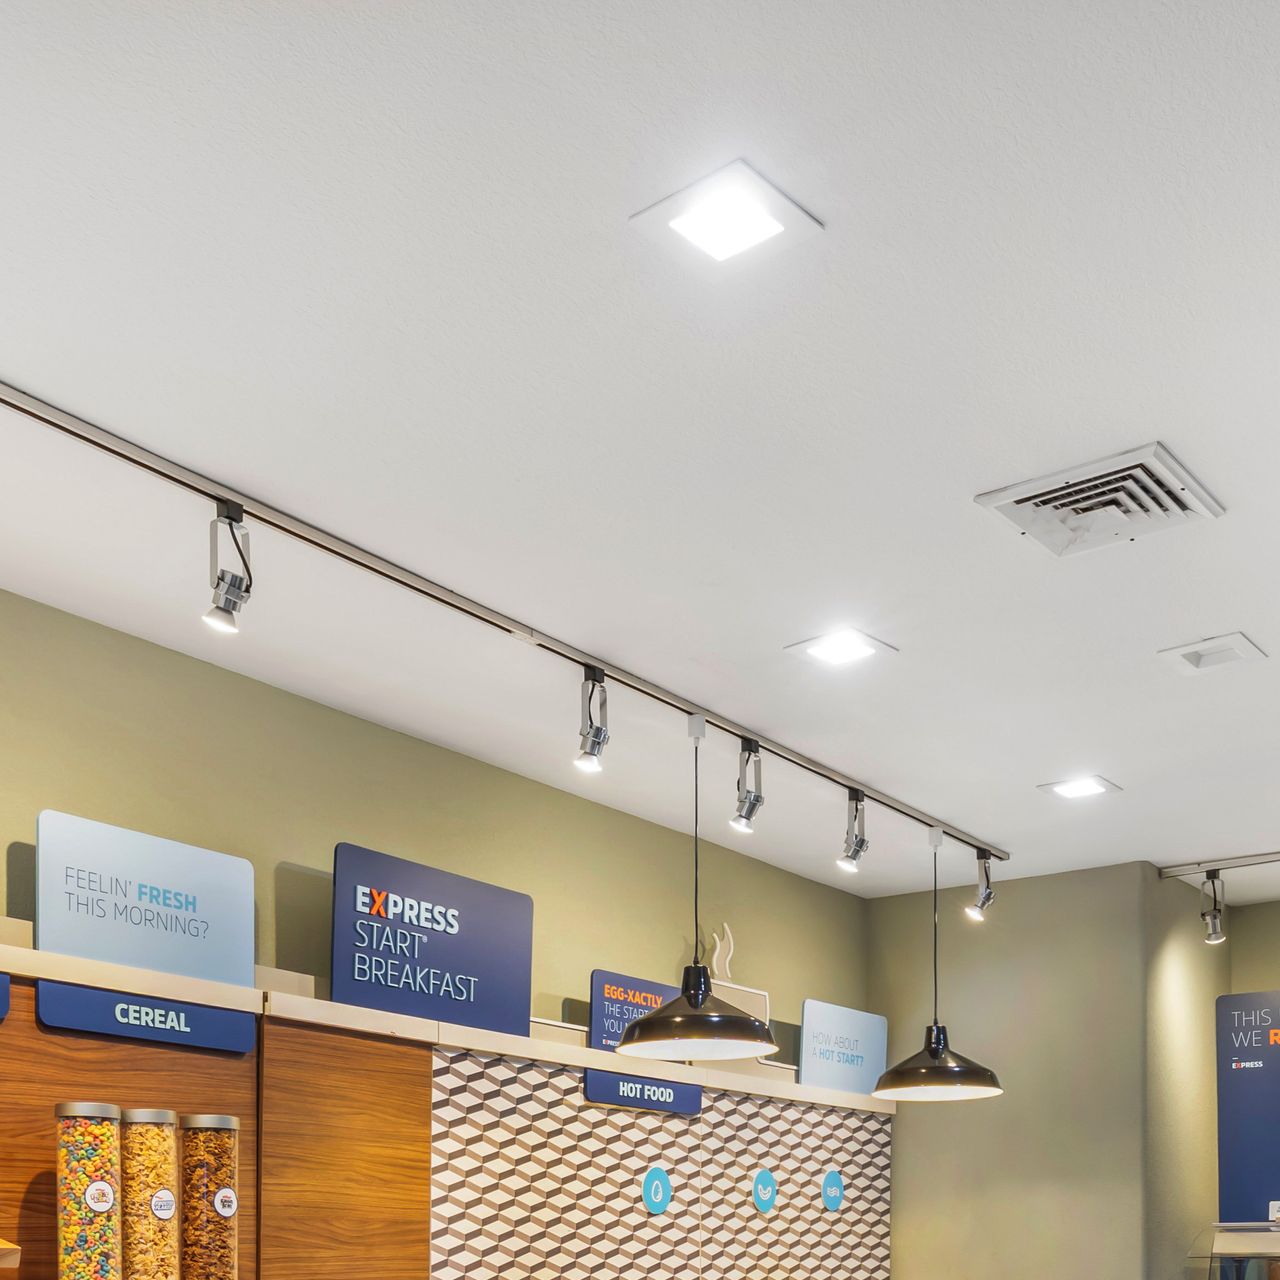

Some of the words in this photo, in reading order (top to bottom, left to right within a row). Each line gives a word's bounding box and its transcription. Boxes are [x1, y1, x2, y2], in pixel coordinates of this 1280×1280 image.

[65, 866, 132, 898] FEELIN'
[137, 883, 197, 913] FRESH
[64, 891, 107, 919] THIS
[114, 902, 209, 939] MORNING?
[355, 885, 460, 935] EXPRESS
[354, 952, 479, 1002] BREAKFAST
[603, 983, 663, 1008] EGG-XACTLY
[114, 1003, 191, 1032] CEREAL
[603, 1001, 621, 1017] THE
[1231, 1008, 1272, 1027] THIS
[603, 1018, 623, 1033] YOU
[812, 1031, 831, 1046] HOW
[833, 1035, 859, 1051] ABOUT
[1231, 1030, 1262, 1048] WE
[811, 1047, 817, 1057] A
[819, 1047, 834, 1061] HOT
[836, 1050, 864, 1068] START?
[1232, 1061, 1263, 1069] EXPRESS
[619, 1081, 642, 1099] HOT
[644, 1085, 674, 1103] FOOD
